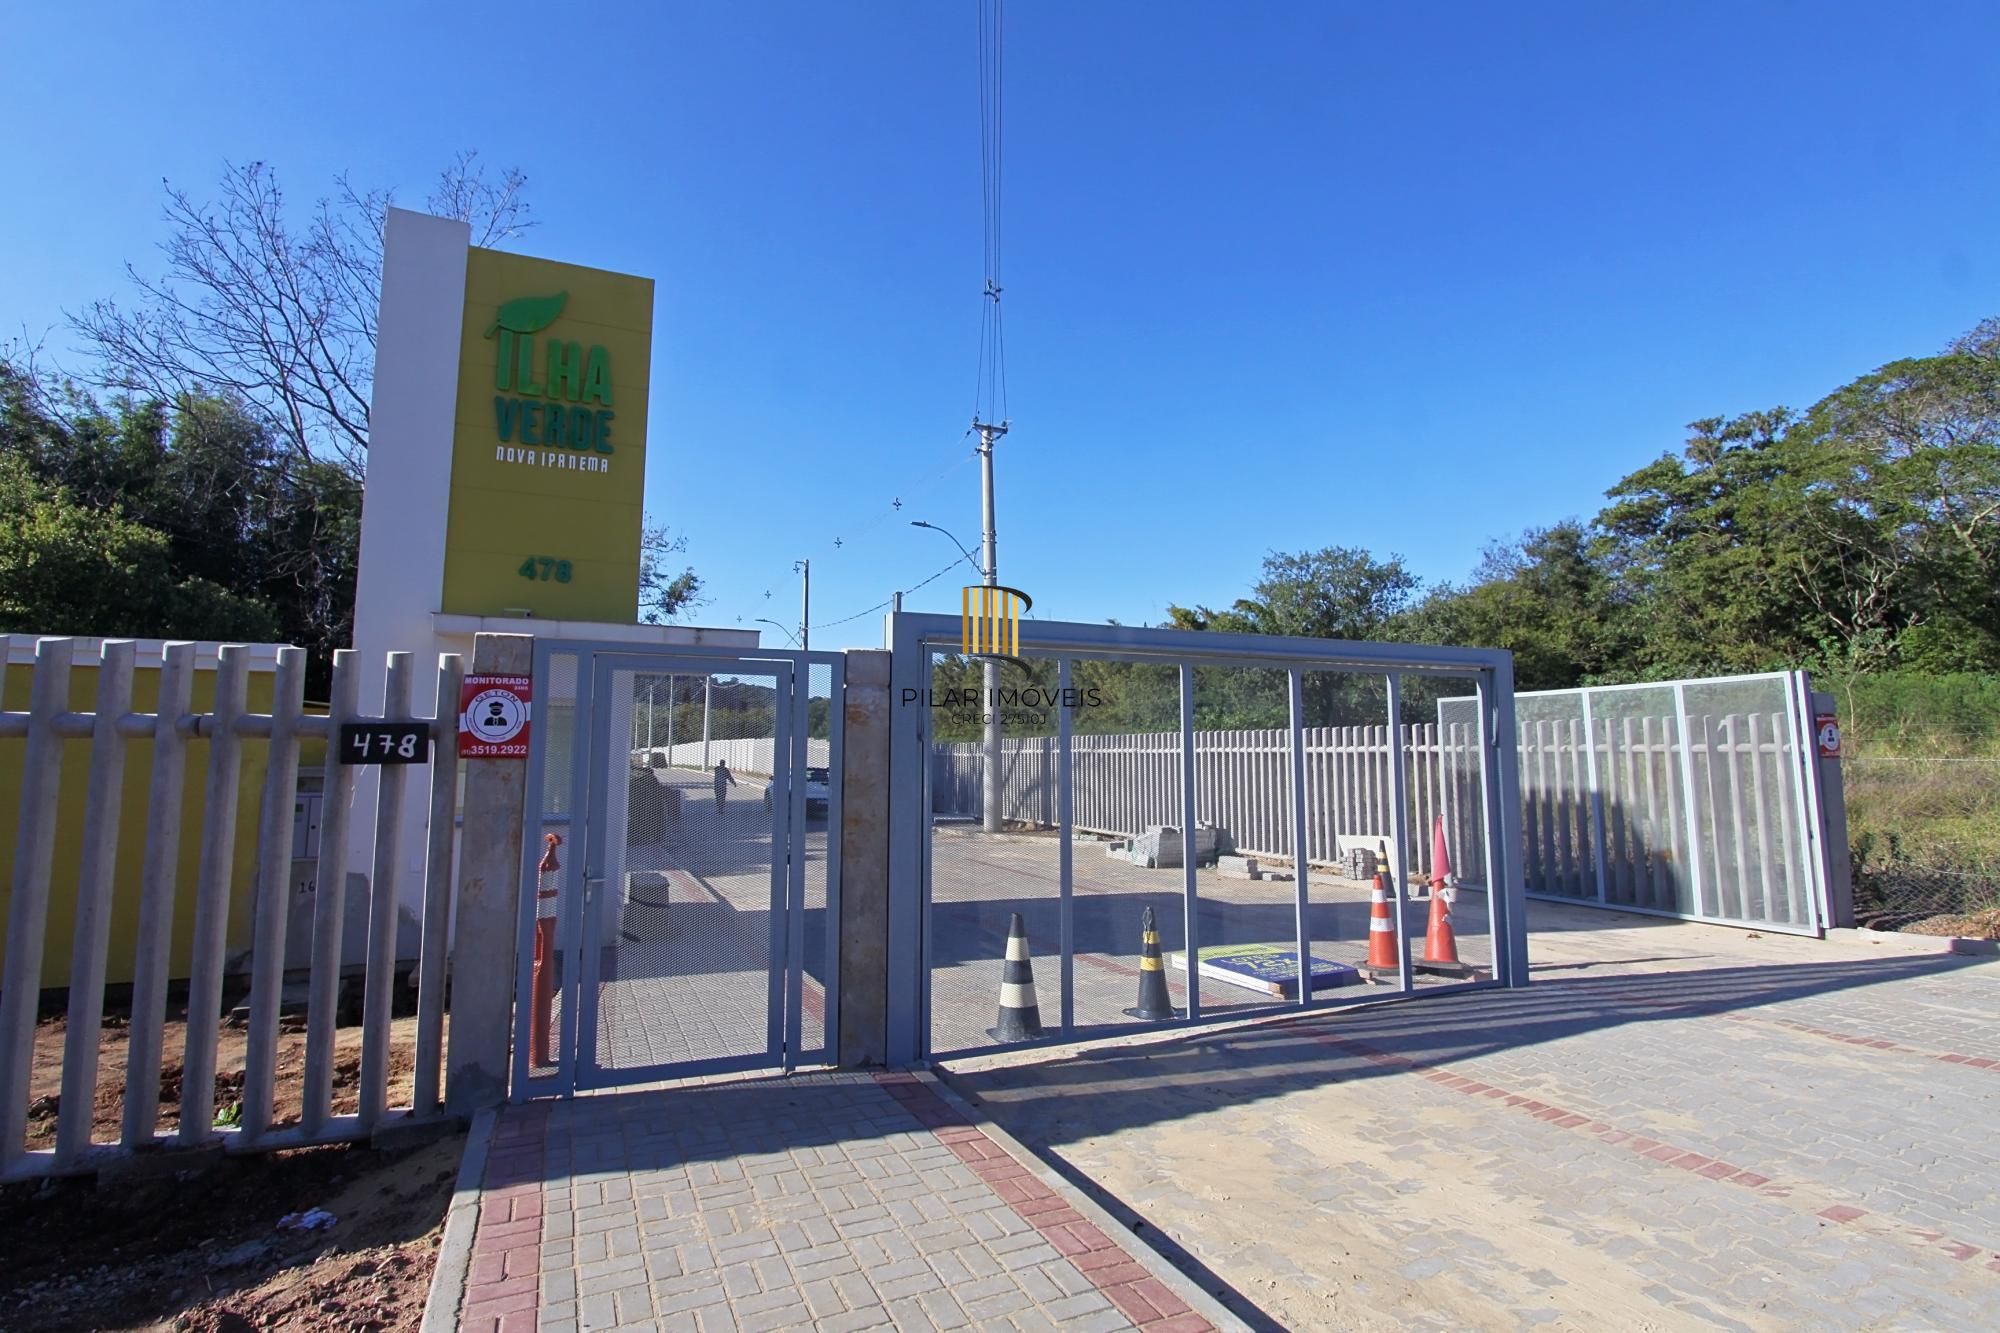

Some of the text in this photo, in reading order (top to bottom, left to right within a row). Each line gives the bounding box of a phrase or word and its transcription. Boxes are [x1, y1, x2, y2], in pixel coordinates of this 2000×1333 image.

[497, 330, 615, 407] ILHA
[494, 395, 616, 455] VERDE
[496, 446, 608, 473] NOVA IPANEMA
[518, 556, 573, 584] 478
[465, 677, 529, 685] MONITORADO
[475, 690, 519, 703] GETON
[353, 733, 417, 758] 478
[471, 745, 527, 754] 3519.2922
